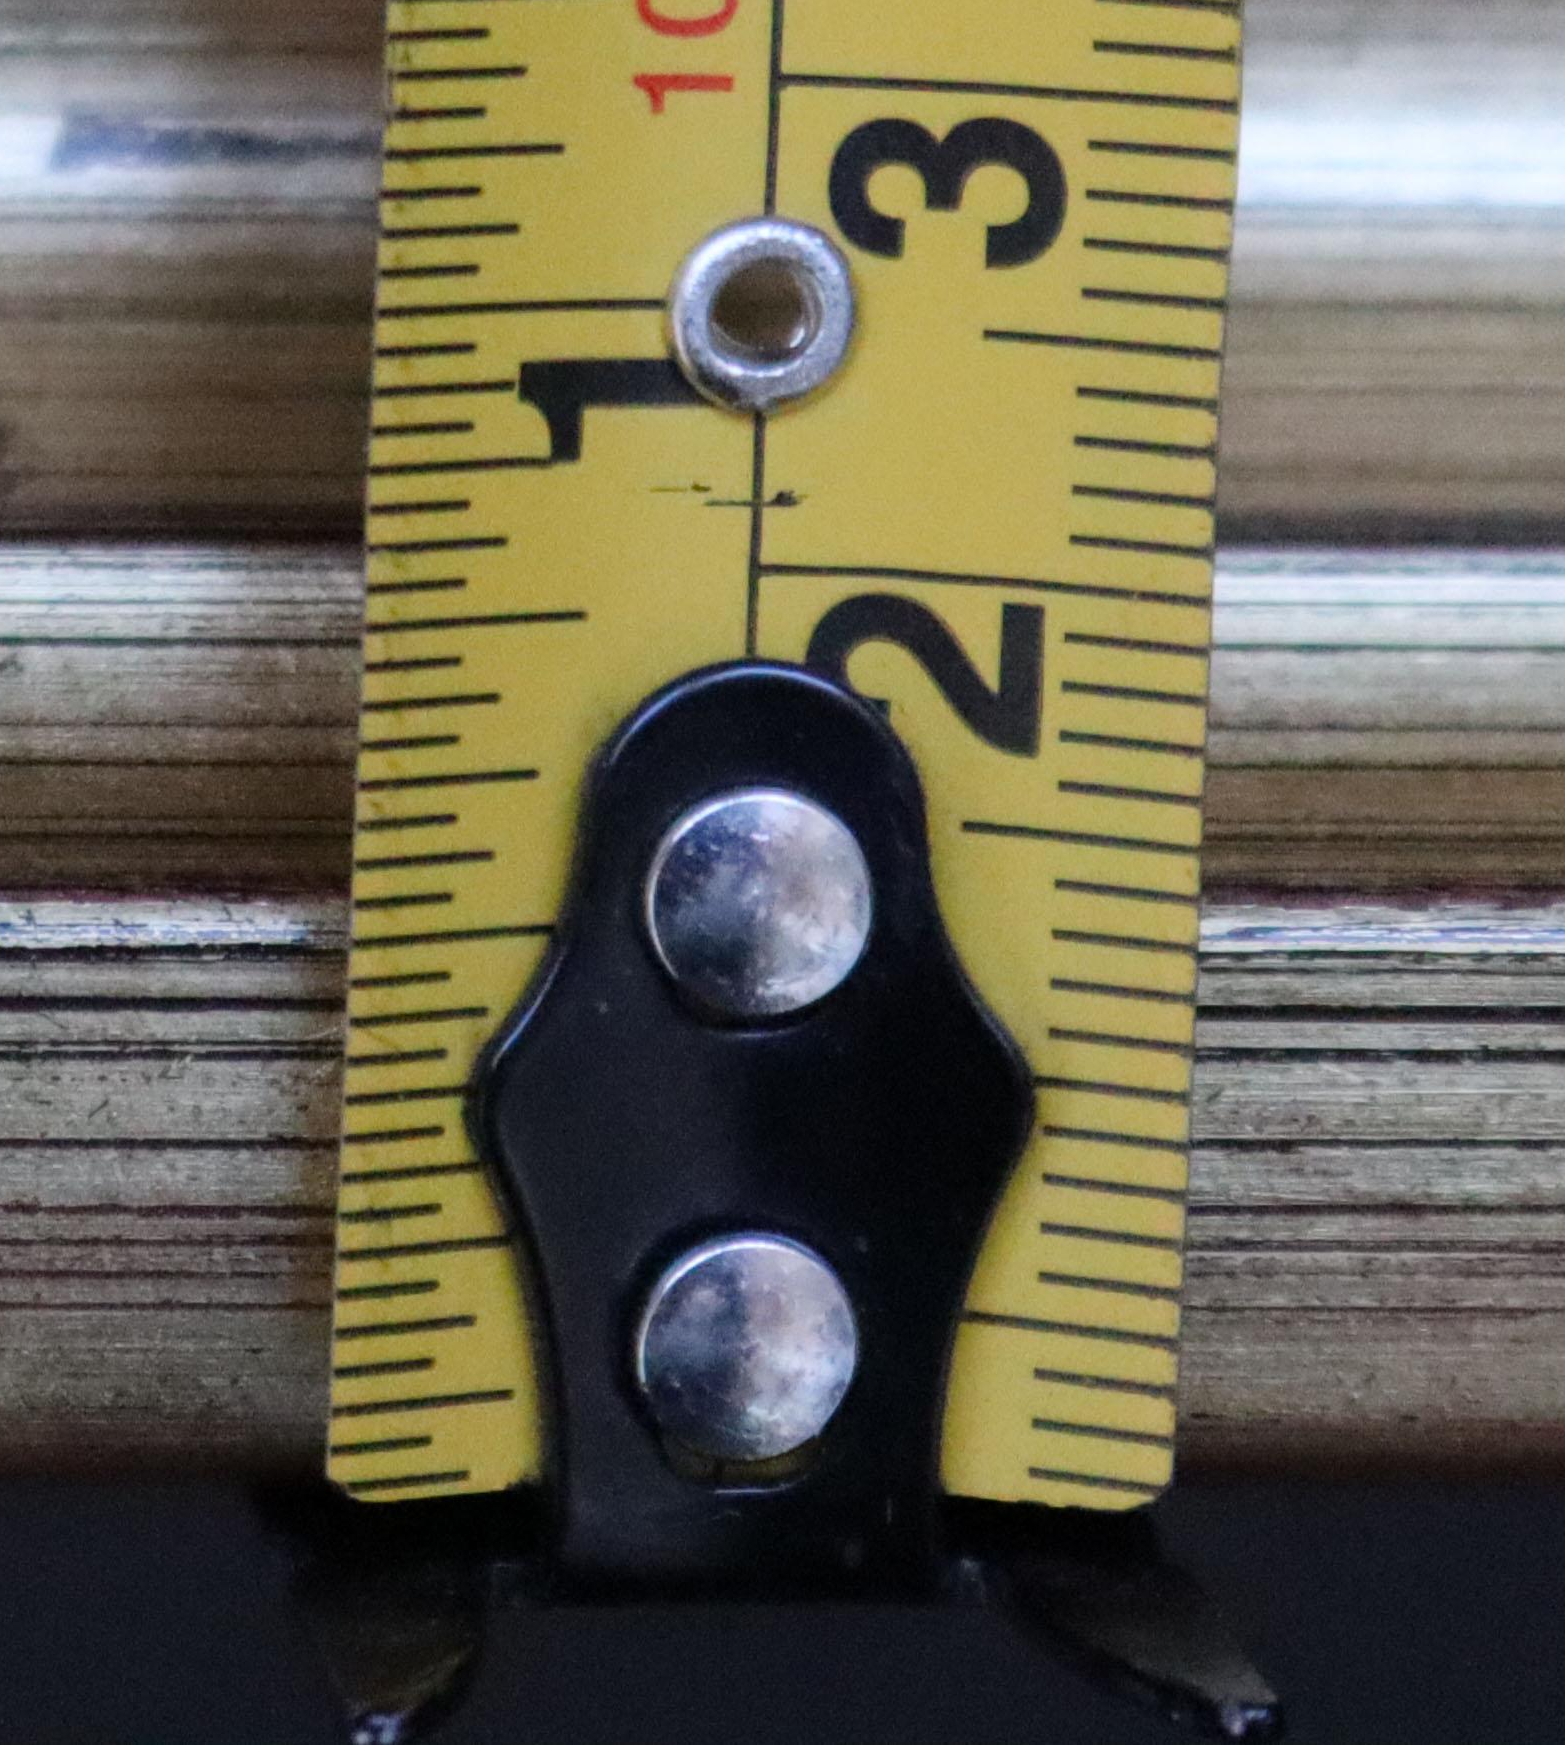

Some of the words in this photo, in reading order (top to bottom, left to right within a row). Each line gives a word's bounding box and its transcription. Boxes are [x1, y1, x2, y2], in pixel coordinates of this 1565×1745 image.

[827, 116, 1068, 269] 3
[518, 357, 715, 463] 1
[805, 592, 1046, 759] 2
